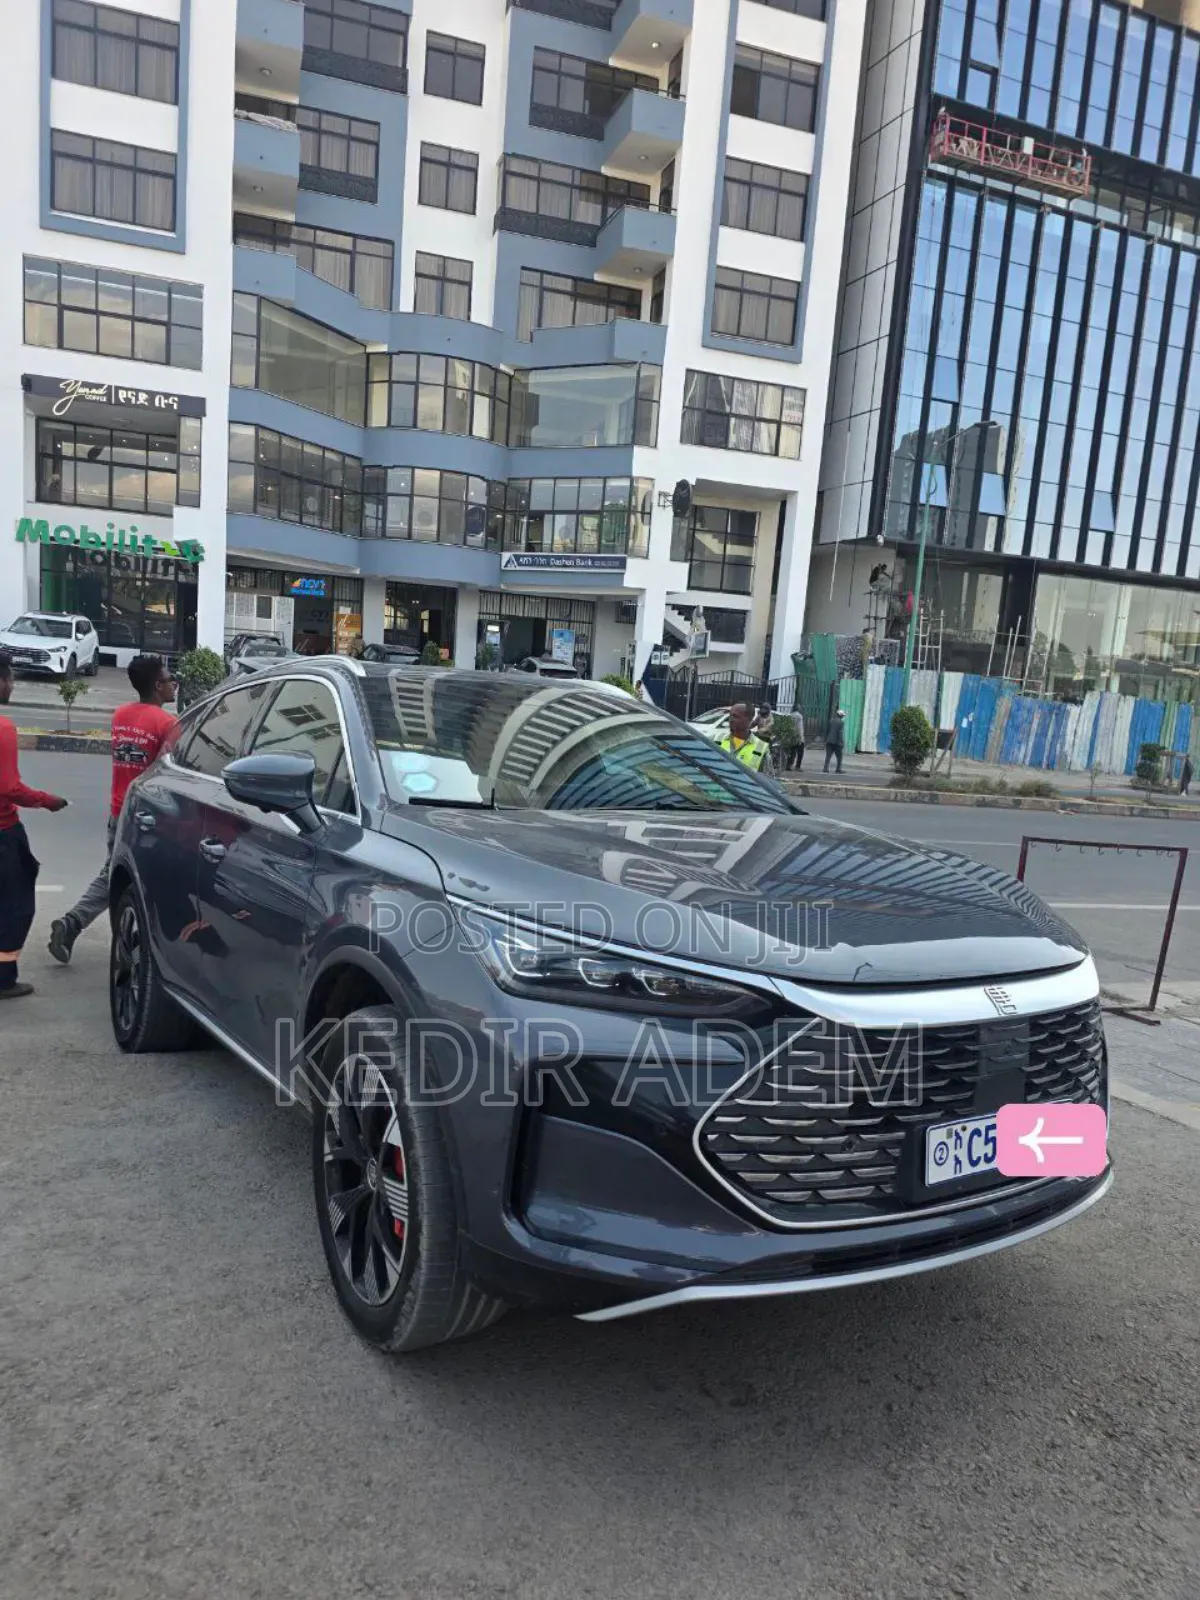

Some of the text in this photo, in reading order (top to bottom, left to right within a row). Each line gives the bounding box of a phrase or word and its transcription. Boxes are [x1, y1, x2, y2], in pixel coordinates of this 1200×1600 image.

[154, 394, 179, 410] ቡና
[550, 558, 574, 567] Dashen
[576, 558, 592, 567] Bank
